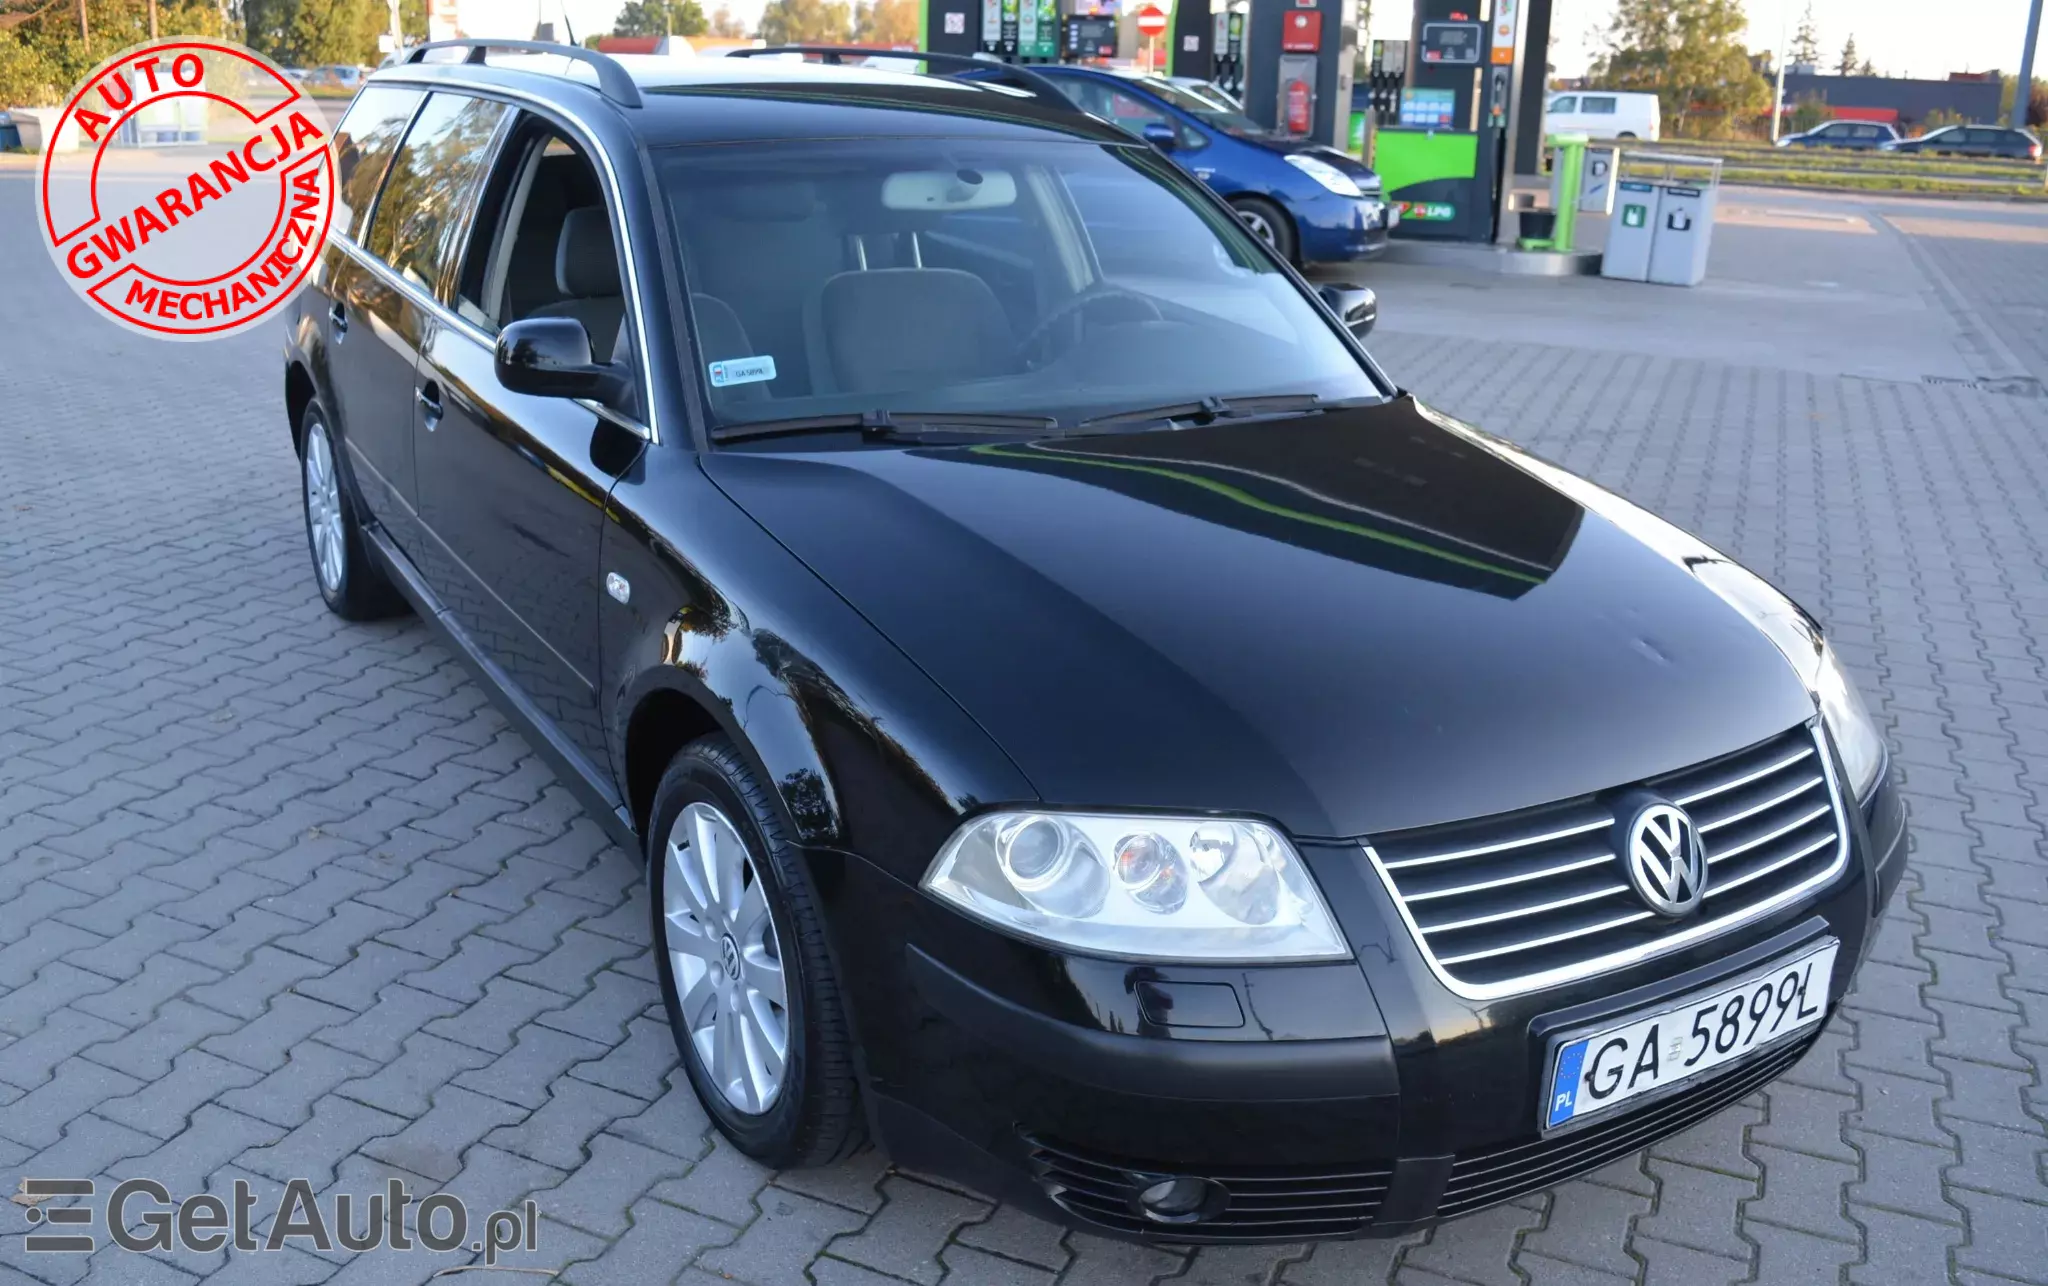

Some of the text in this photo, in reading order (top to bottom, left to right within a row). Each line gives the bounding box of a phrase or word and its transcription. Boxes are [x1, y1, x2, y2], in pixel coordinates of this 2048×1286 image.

[1587, 962, 1819, 1100] GA 5899L
[1554, 1090, 1573, 1112] PL
